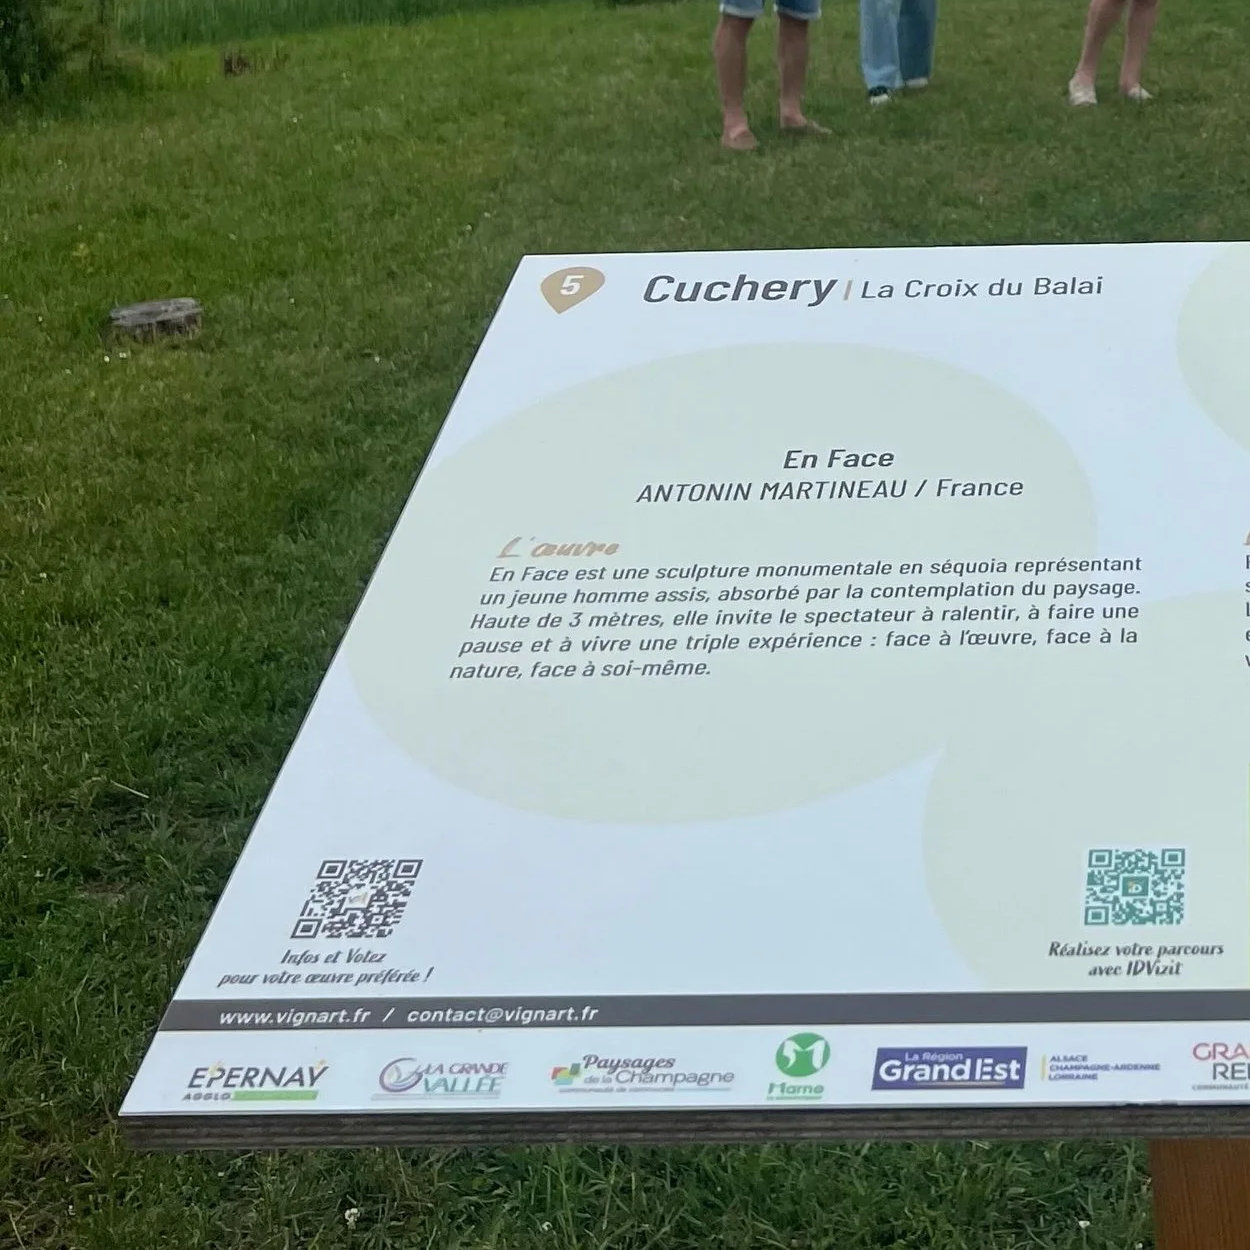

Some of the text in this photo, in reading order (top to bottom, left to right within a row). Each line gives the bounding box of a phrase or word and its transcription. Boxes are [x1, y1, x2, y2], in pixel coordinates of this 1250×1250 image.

[560, 275, 585, 296] 5
[643, 274, 1104, 308] Cuchery La Croix du Balai
[783, 449, 895, 469] En Face
[636, 479, 1024, 503] ANTONIN MARTINEAU France
[490, 557, 1142, 582] En Face est une sculpture monumentale en séquoia représentant
[470, 604, 1139, 630] Haute de 3 mètres, elle invite le spectateur à ralentir, à faire une
[458, 641, 523, 658] pause
[531, 638, 553, 653] et
[559, 636, 573, 653] à
[582, 636, 632, 652] vivre
[639, 638, 678, 651] une
[686, 634, 740, 654] triple
[748, 632, 863, 653] expérience
[886, 631, 931, 647] face
[939, 630, 952, 646] à
[1047, 628, 1091, 645] face
[1100, 628, 1112, 644] à
[1121, 627, 1138, 644] la
[280, 948, 388, 967] Infos et Votez
[1048, 941, 1225, 959] Réalisez votre parcours
[217, 968, 421, 989] pour votre œuvre préférée
[1088, 959, 1183, 977] avec IDVizit
[220, 1006, 600, 1027] www.vignart.fr contact@vignart.fr
[582, 1054, 676, 1075] Paysages
[905, 1051, 964, 1062] La Région
[615, 1070, 735, 1087] Champagne
